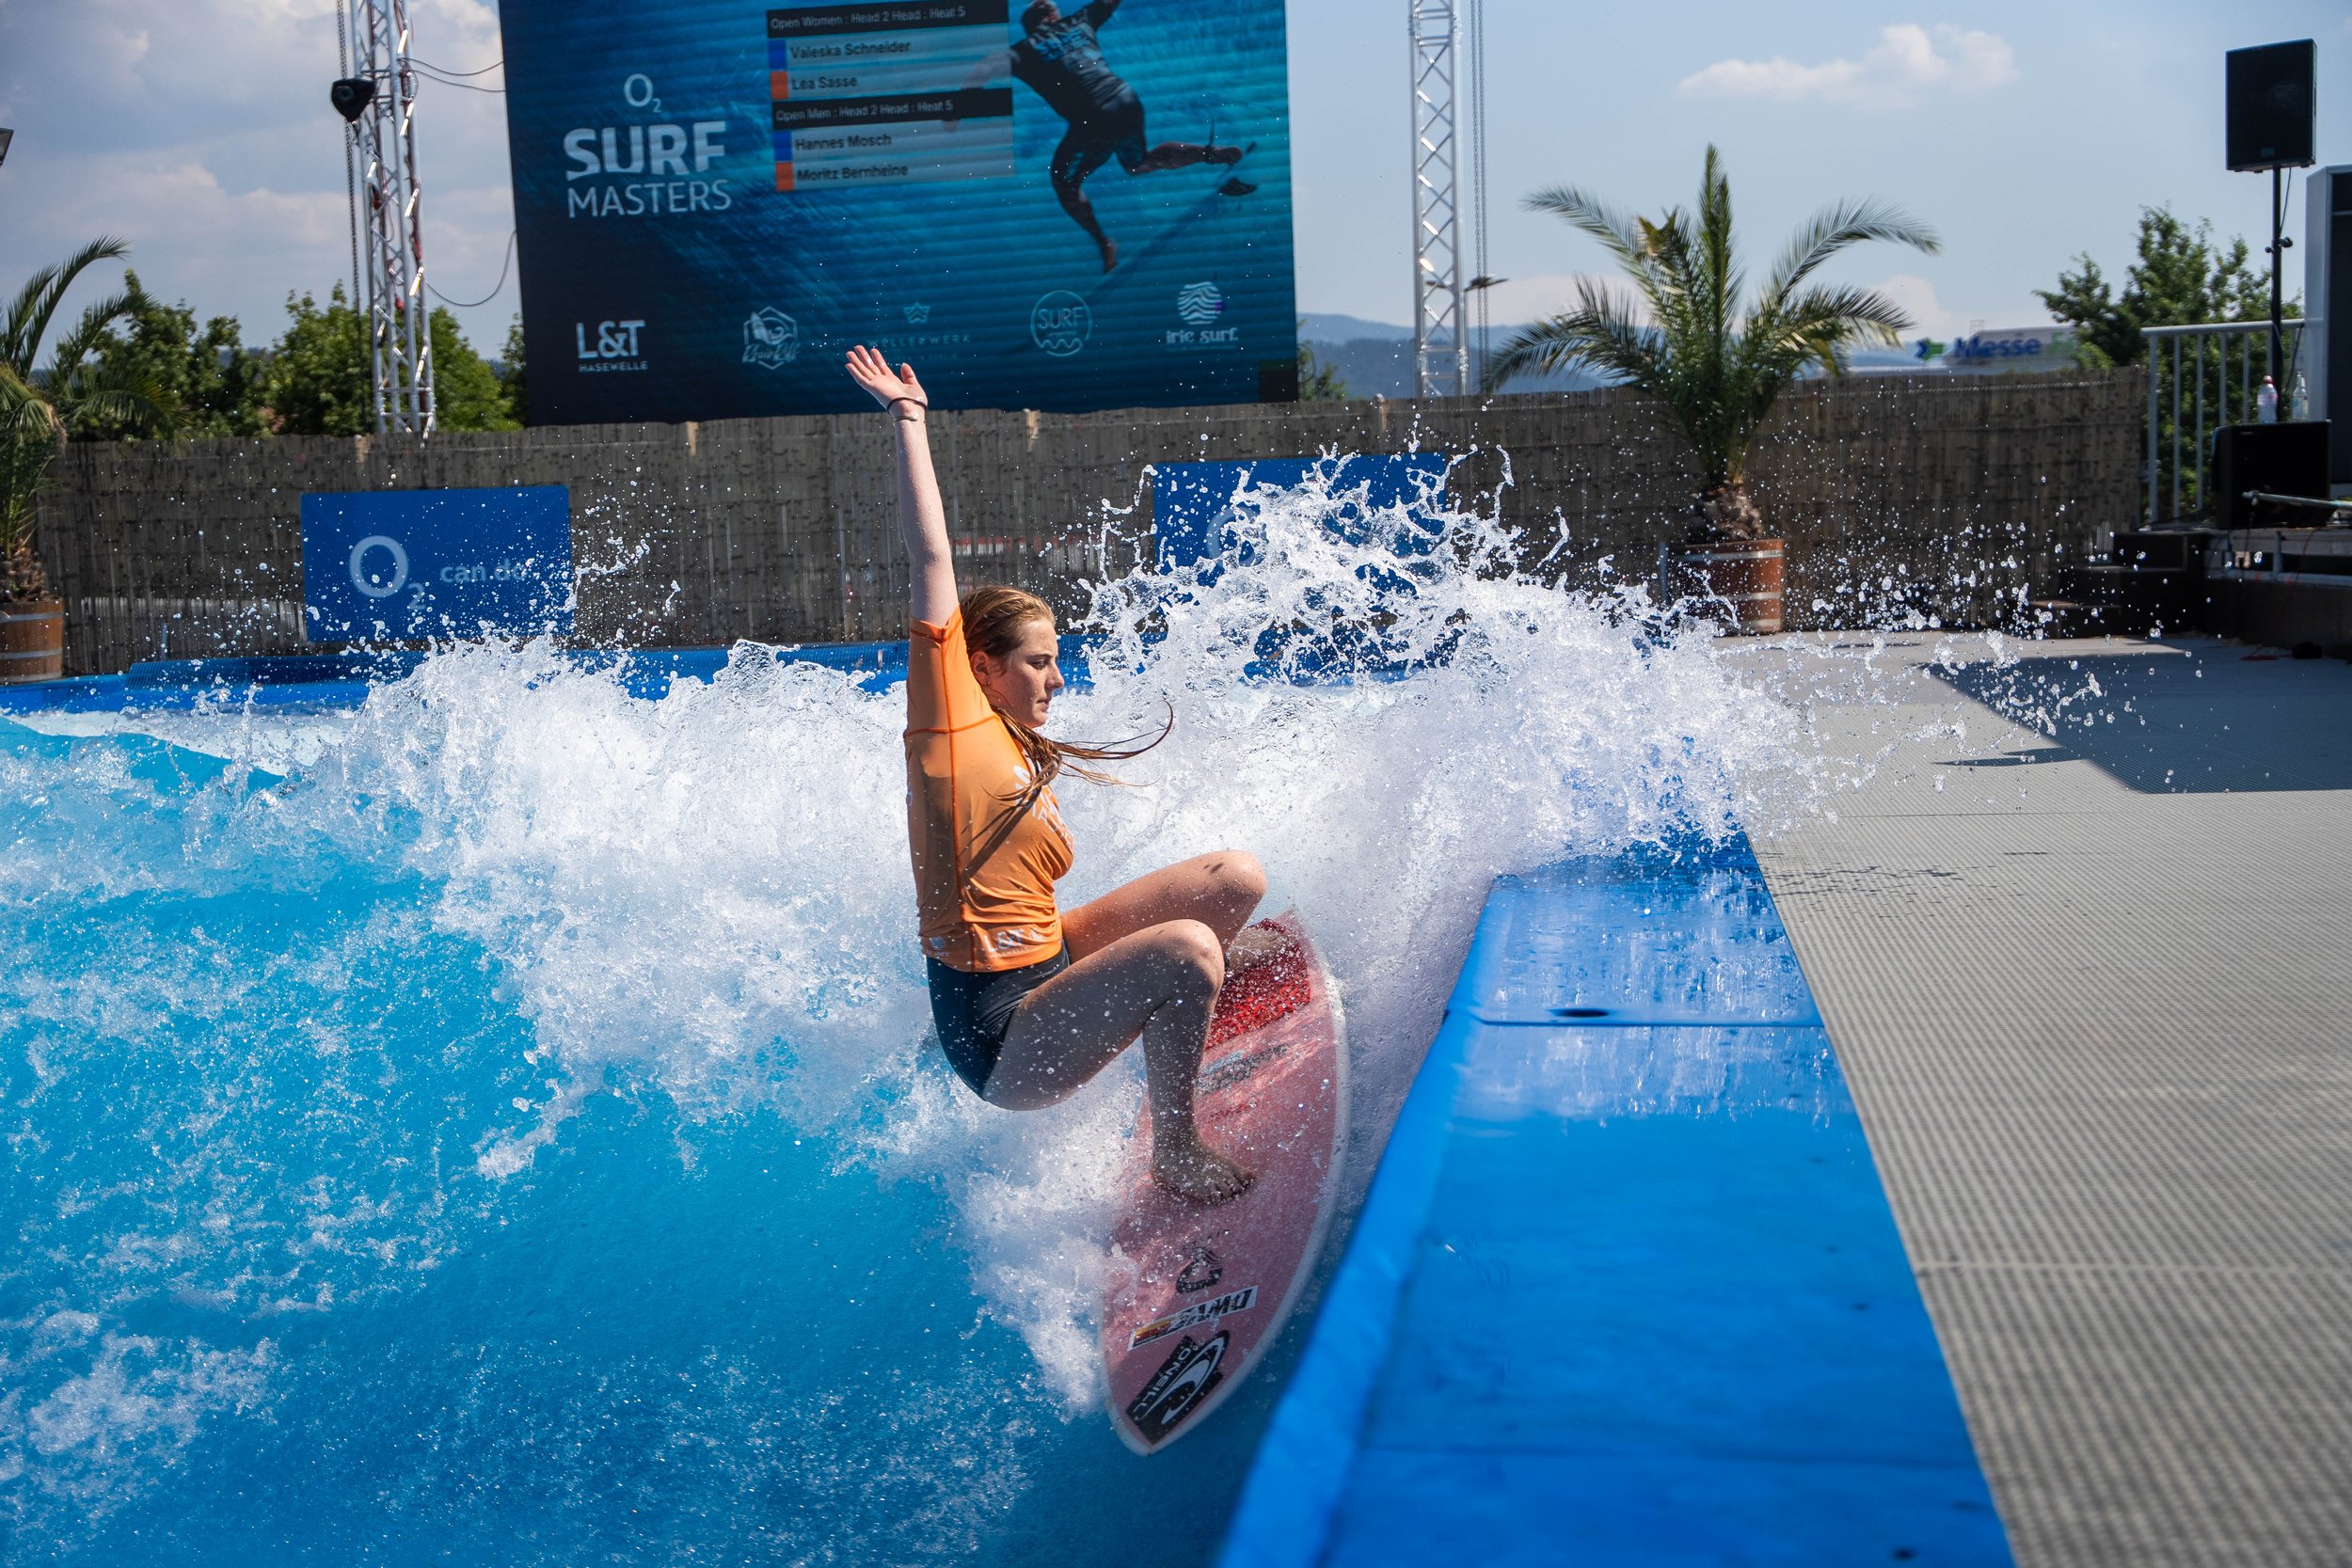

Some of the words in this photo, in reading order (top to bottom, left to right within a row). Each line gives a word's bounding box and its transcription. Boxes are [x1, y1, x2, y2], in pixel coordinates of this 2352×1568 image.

[770, 17, 800, 30] Open
[802, 15, 843, 28] Women
[850, 12, 879, 24] Head
[882, 10, 890, 23] 2
[893, 9, 921, 22] Head
[930, 8, 955, 20] Heat
[790, 43, 842, 59] Valeska
[844, 40, 911, 56] Schneider
[791, 77, 816, 91] Lea
[818, 75, 858, 89] Sasse
[775, 110, 805, 122] Open
[807, 107, 832, 120] Men
[838, 104, 868, 118] Head
[870, 103, 879, 116] 2
[881, 102, 910, 115] Head
[917, 100, 944, 113] Heat
[563, 120, 726, 181] SURF
[795, 136, 845, 150] Hannes
[848, 133, 892, 147] Mosch
[797, 166, 838, 182] Moritz
[566, 179, 732, 218] MASTERS
[1037, 307, 1085, 329] SURF
[575, 319, 646, 359] L&T
[1953, 337, 2042, 359] Messe
[440, 562, 486, 584] can
